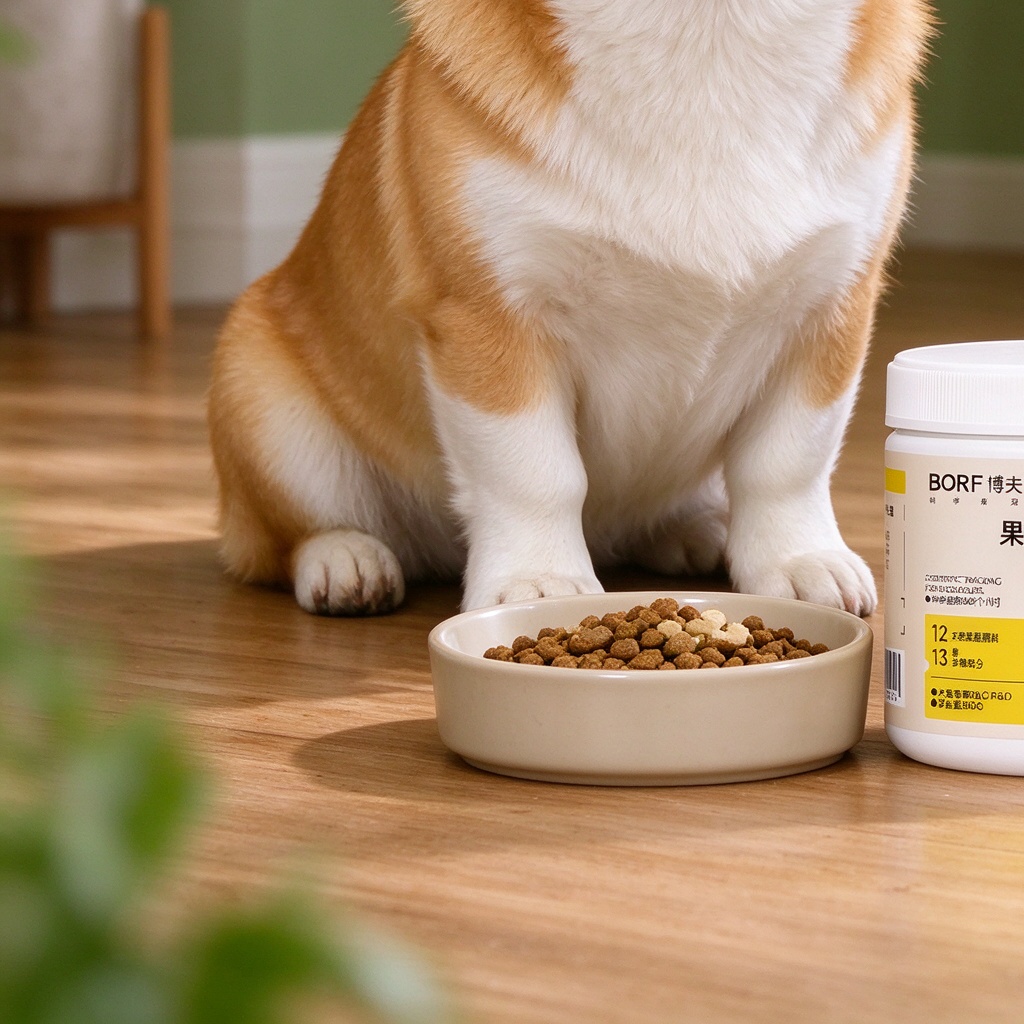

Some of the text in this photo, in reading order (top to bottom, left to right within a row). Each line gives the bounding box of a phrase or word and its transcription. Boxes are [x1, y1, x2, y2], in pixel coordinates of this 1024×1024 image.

[929, 473, 1022, 493] BORF 博夫
[932, 624, 948, 642] 12
[932, 649, 948, 666] 13
